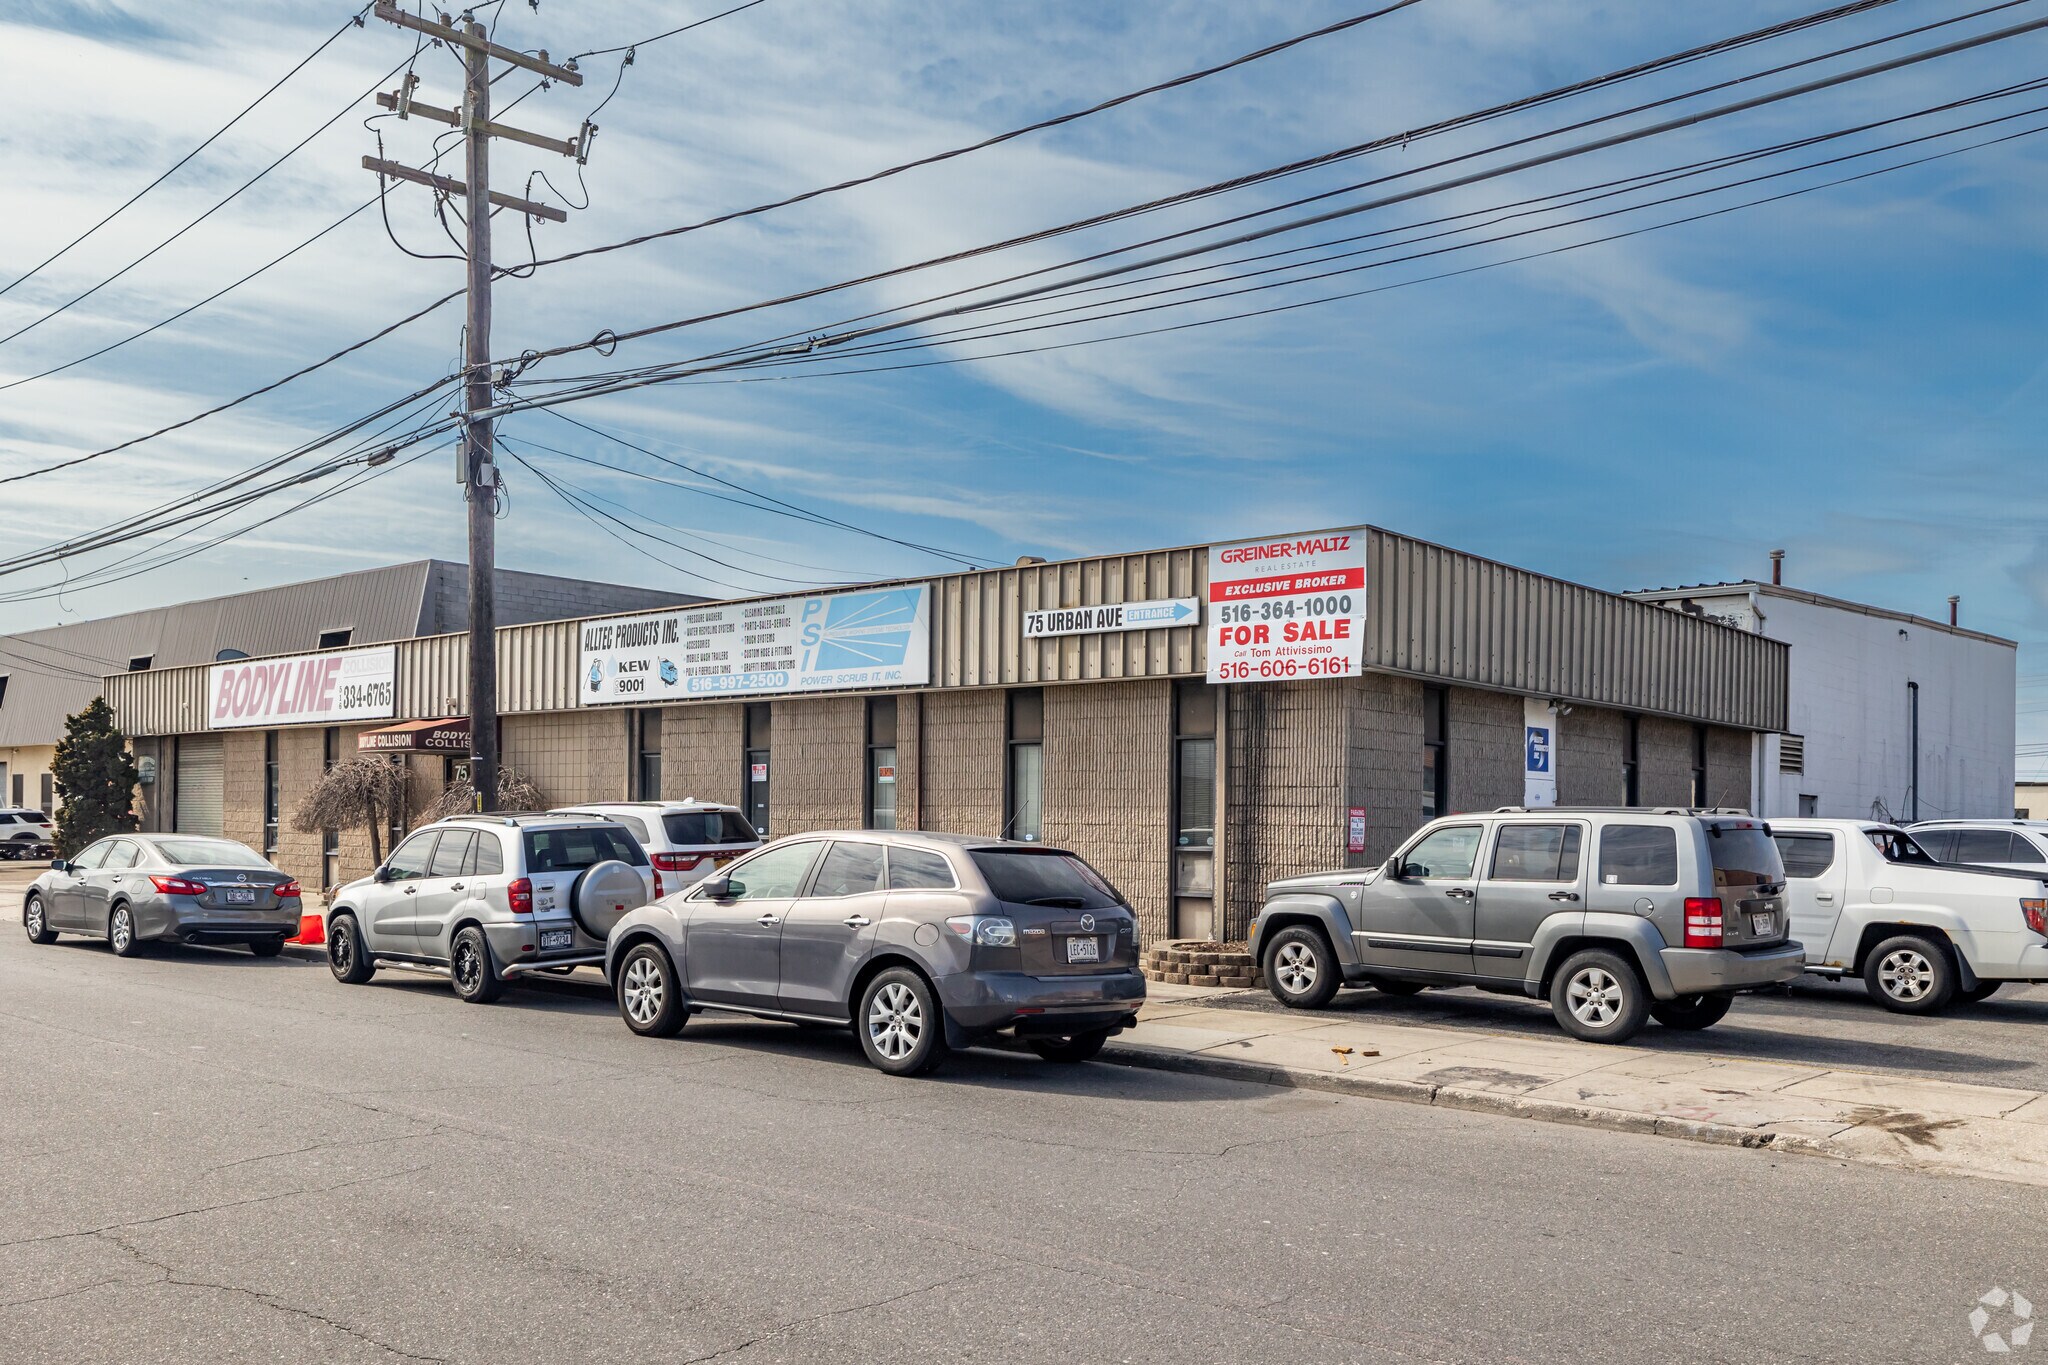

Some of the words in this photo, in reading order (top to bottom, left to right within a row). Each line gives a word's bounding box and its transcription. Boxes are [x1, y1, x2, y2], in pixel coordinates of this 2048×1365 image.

[1221, 536, 1351, 564] GREINER-MALTZ
[1255, 564, 1278, 573] REAL
[1281, 560, 1317, 571] ESTATE
[1225, 580, 1291, 596] EXCLUSIVE
[1295, 574, 1347, 589] BROKER
[744, 607, 763, 618] CLEANING
[763, 604, 785, 616] CHEMICALS
[1221, 595, 1352, 624] 516-364-1000
[686, 613, 705, 624] PRESSURE
[705, 611, 723, 621] WASHERS
[1027, 614, 1043, 634] 75
[1047, 609, 1093, 632] URBAN
[1097, 607, 1123, 628] AVE
[1128, 607, 1175, 620] ENTRANCE
[584, 626, 613, 652] ALLTEC
[615, 620, 660, 649] PRODUCTS
[661, 618, 680, 644] INC.
[686, 626, 698, 636] WATER
[698, 625, 718, 635] RECYCLING
[718, 623, 735, 634] SYSTEMS
[1219, 624, 1269, 647] FOR
[1283, 619, 1351, 643] SALE
[686, 639, 710, 650] ACCESSORIES
[744, 634, 757, 645] TRUCK
[757, 633, 775, 644] SYSTEMS
[686, 653, 700, 663] MOBILE
[711, 651, 729, 661] TRAILERS
[744, 648, 760, 659] CUSTOM
[760, 647, 770, 657] HOSE
[774, 645, 792, 656] FITTINGS
[1234, 650, 1247, 658] Call
[1250, 648, 1271, 658] Tom
[1275, 645, 1332, 657] Attivissimo
[344, 655, 392, 674] COLLISION
[618, 659, 651, 673] KEW
[743, 662, 760, 673] GRAFFITI
[760, 661, 777, 672] REMOVAL
[777, 659, 796, 670] SYSTEMS
[1219, 656, 1349, 679] 516-606-6161
[619, 678, 644, 693] 9001
[692, 672, 784, 691] 516-997-2500
[800, 675, 833, 686] POWER
[836, 673, 868, 684] SCRUB
[884, 671, 902, 681] INC.
[214, 657, 343, 719] BODYLINE
[343, 681, 392, 709] 334-6765
[377, 734, 412, 747] COLLISION
[425, 738, 471, 749] COLLIS
[454, 765, 468, 781] 75
